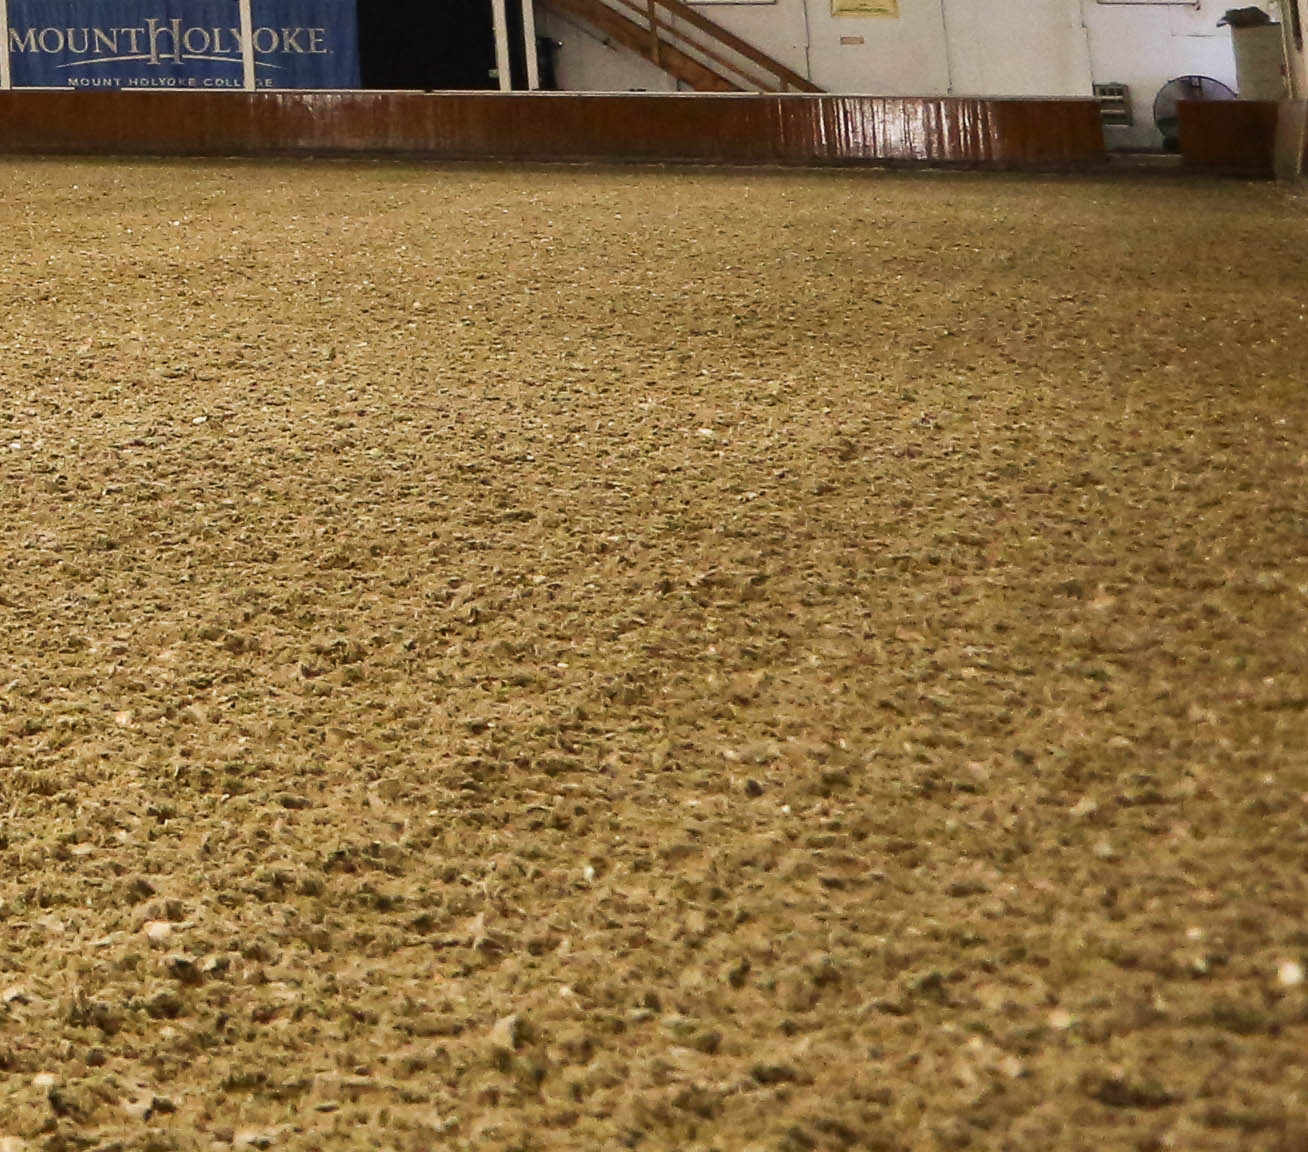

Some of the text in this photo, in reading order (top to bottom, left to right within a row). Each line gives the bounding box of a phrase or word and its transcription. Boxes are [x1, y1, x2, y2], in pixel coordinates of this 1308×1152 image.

[68, 78, 272, 87] MOUNT HOLYOKE COLLGE
